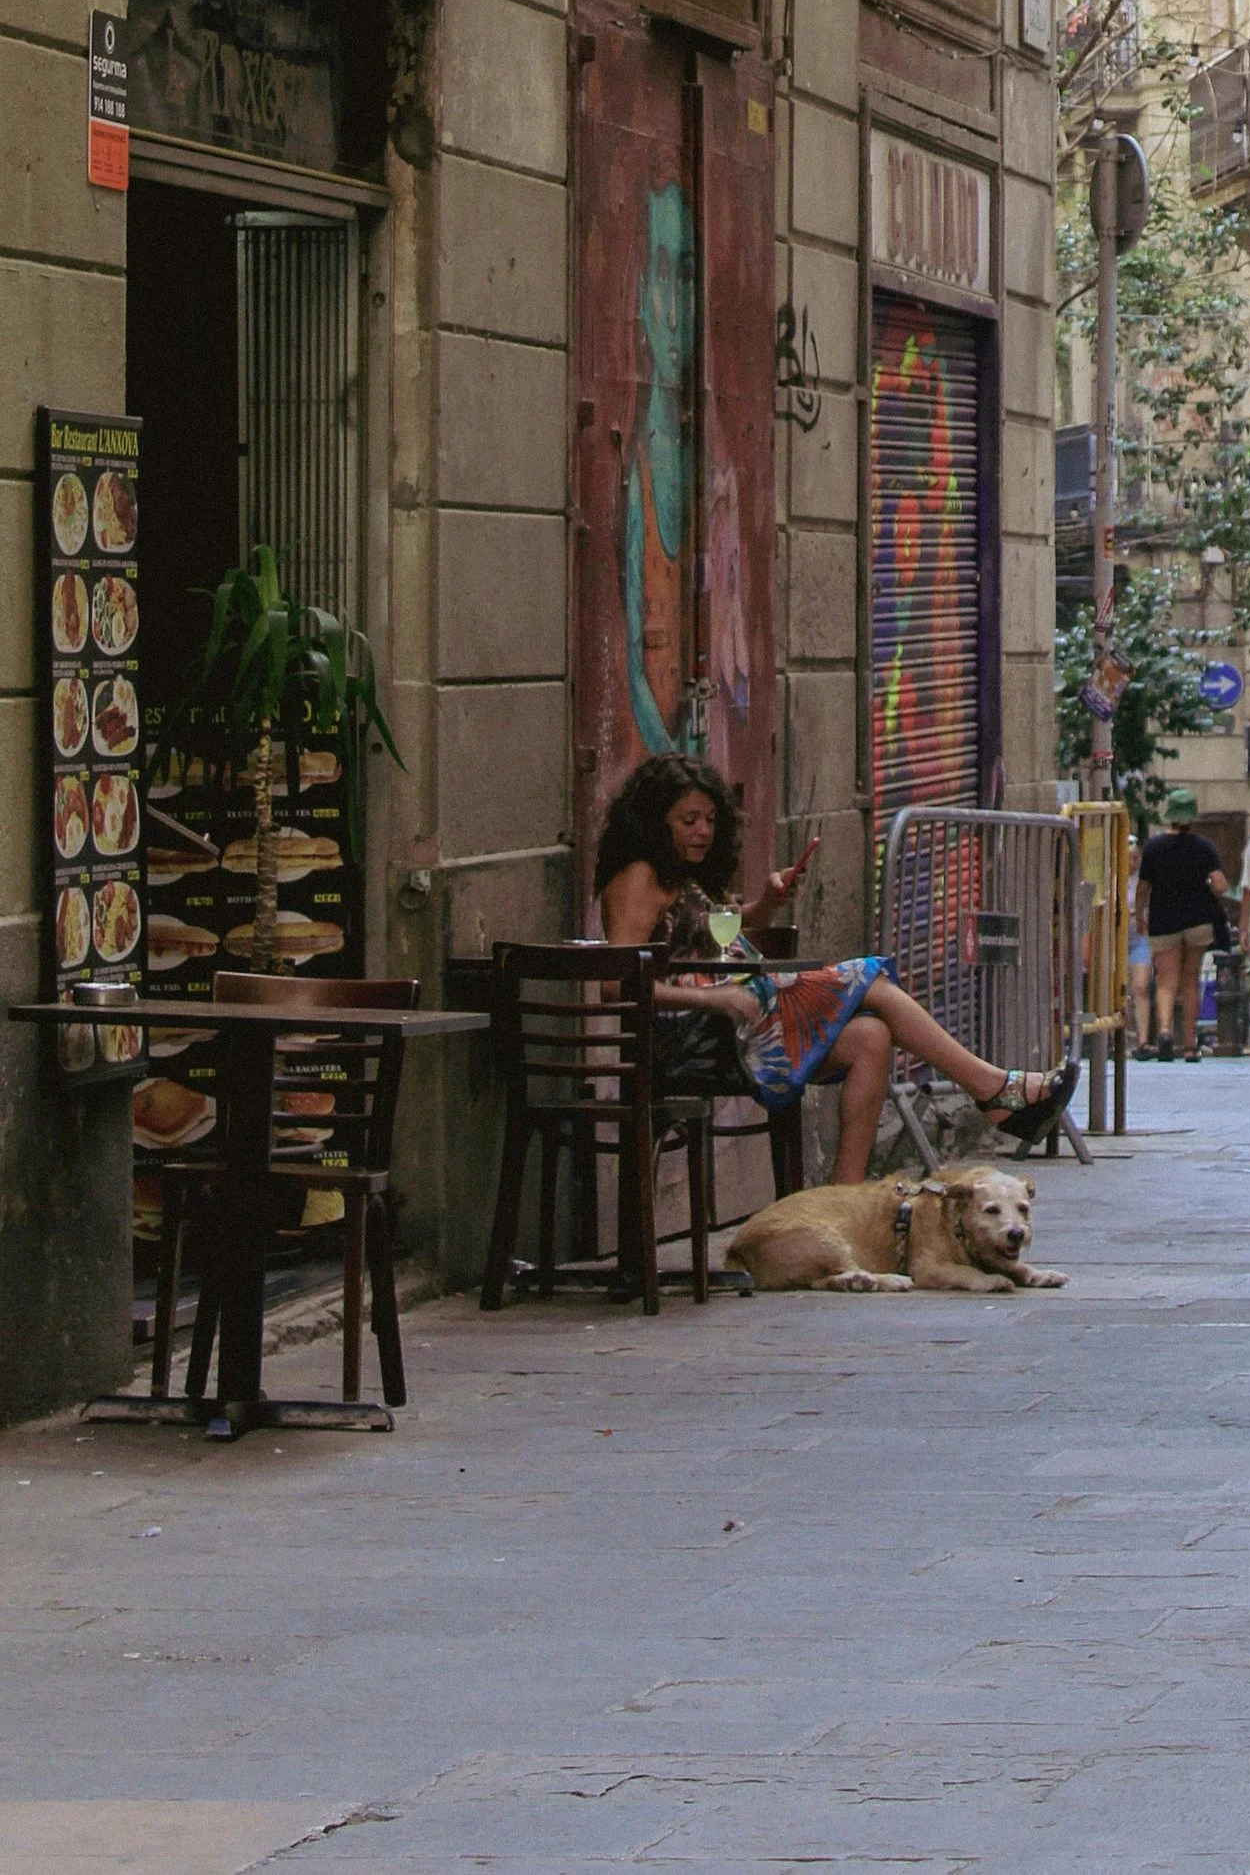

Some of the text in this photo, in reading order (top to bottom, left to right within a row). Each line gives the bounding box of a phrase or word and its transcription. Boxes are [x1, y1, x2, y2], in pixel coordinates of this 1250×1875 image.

[93, 55, 127, 78] segurma
[51, 422, 139, 456] Bar Restaurant L'ANXOVA
